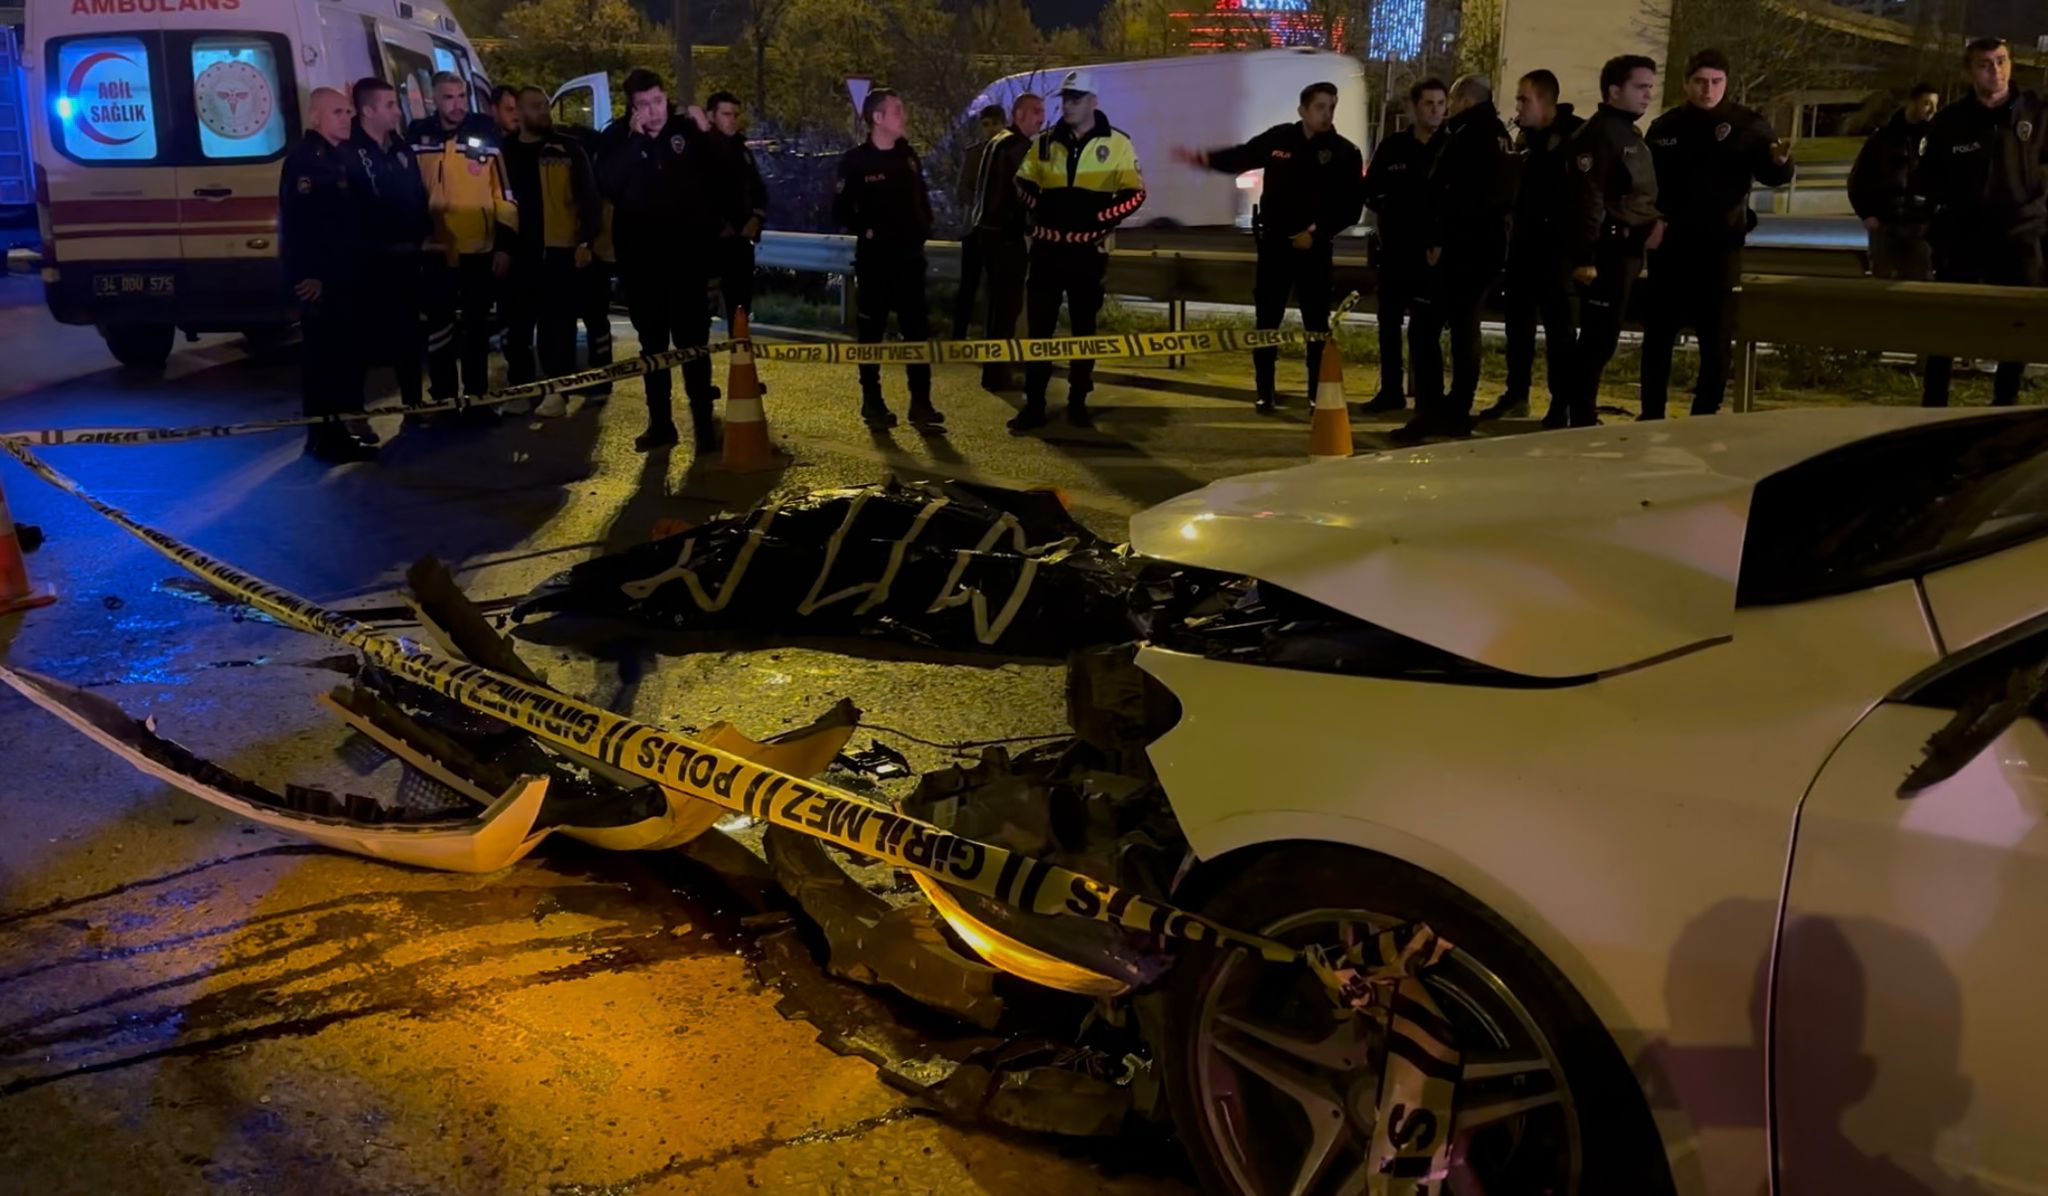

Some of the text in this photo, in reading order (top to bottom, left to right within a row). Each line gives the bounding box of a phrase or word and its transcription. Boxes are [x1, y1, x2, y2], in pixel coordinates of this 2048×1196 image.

[91, 104, 146, 123] SAĞLIK
[636, 735, 745, 799] POLİS
[780, 781, 985, 881] GİRİLMEZ
